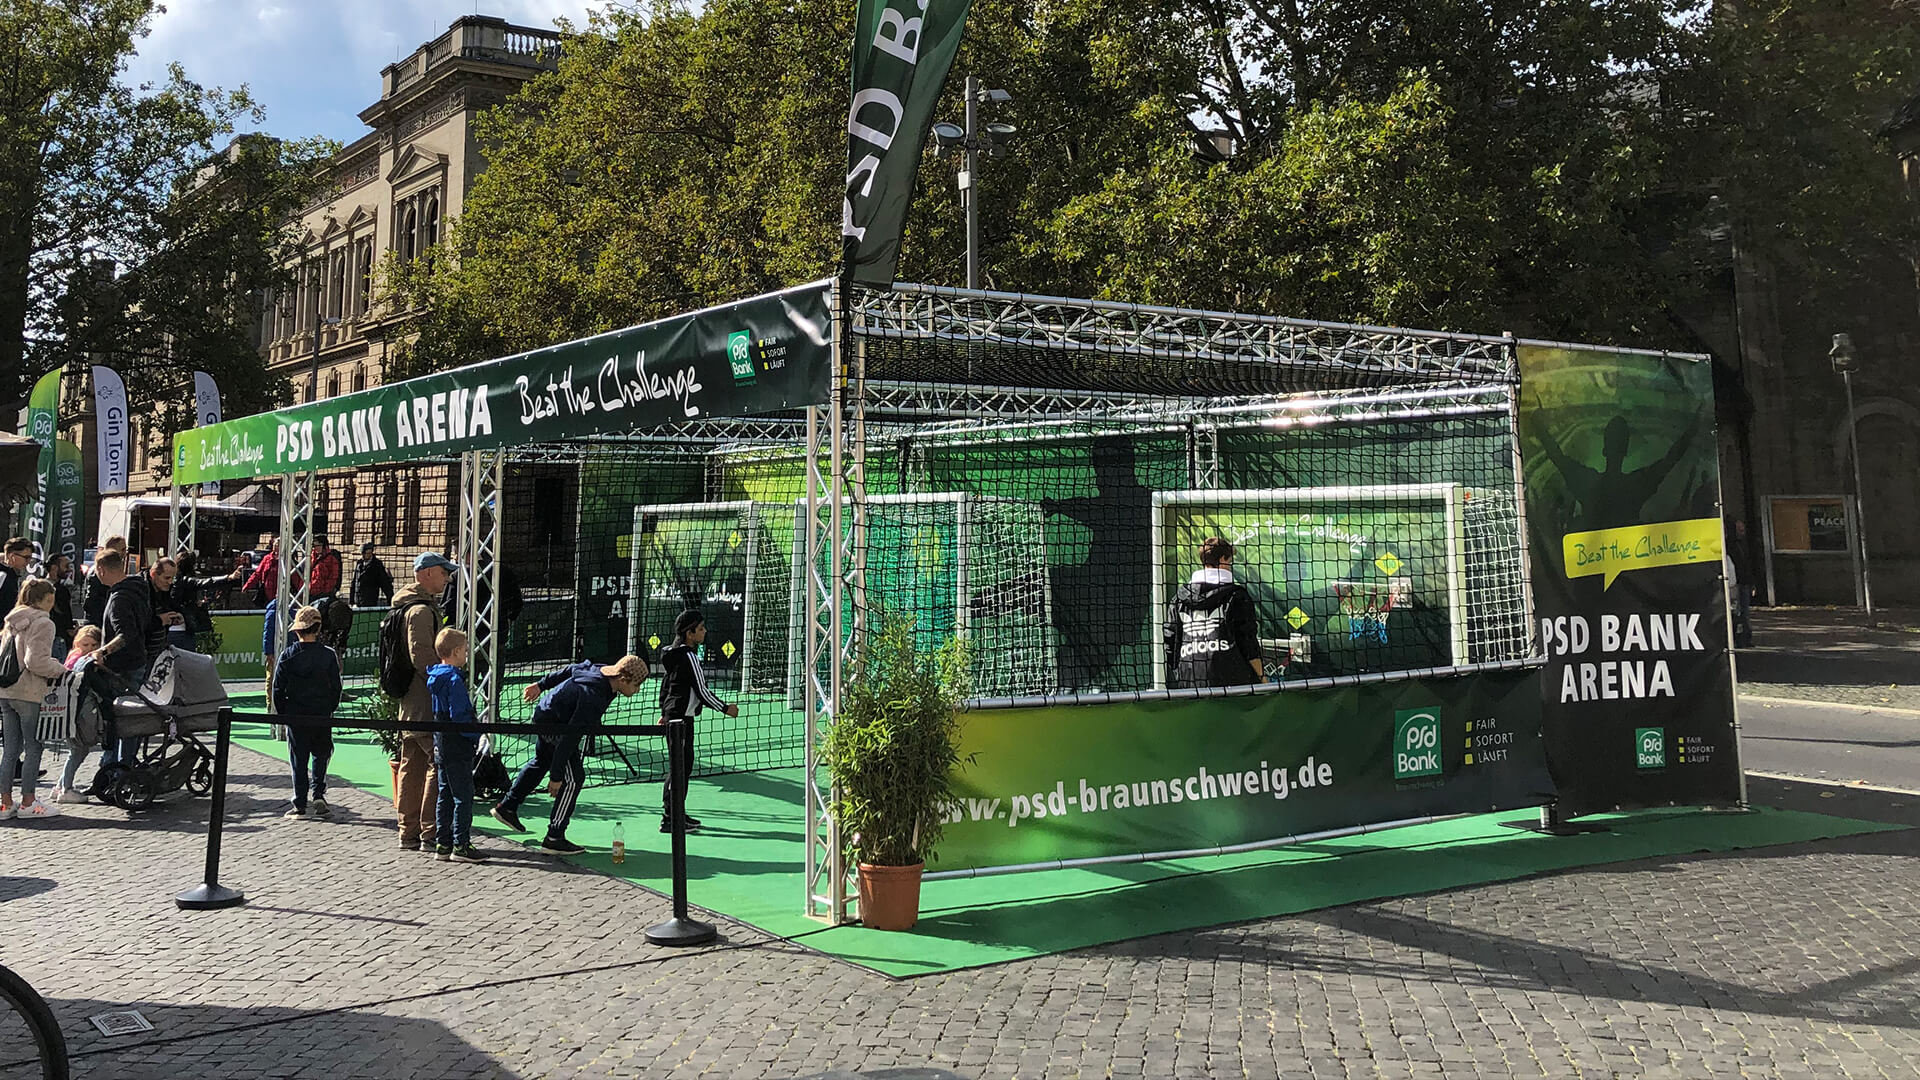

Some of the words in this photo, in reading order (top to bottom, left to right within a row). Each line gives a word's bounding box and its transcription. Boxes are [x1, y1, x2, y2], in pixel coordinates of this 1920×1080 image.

[766, 347, 786, 358] SOFORT
[732, 361, 753, 375] Bank
[516, 374, 559, 425] Beat
[560, 365, 595, 415] the
[598, 350, 702, 417] Challenge
[107, 406, 123, 436] Gin
[276, 420, 313, 464] PSD
[321, 405, 387, 459] BANK
[396, 384, 493, 448] ARENA
[108, 440, 123, 486] Tonic
[1225, 520, 1261, 545] Beat
[1294, 514, 1368, 554] Challenge
[1814, 517, 1845, 527] PEACE
[1574, 542, 1608, 566] Beat
[1610, 539, 1631, 561] the
[1635, 534, 1701, 560] Challenge
[1542, 615, 1590, 656] PSD
[1601, 613, 1705, 652] BANK
[1180, 638, 1230, 658] adidas
[1560, 660, 1676, 704] ARENA
[1406, 724, 1437, 750] psd
[1476, 718, 1496, 731] FAIR
[1475, 732, 1514, 748] SOFORT
[1397, 751, 1439, 773] Bank
[1638, 753, 1664, 765] Bank
